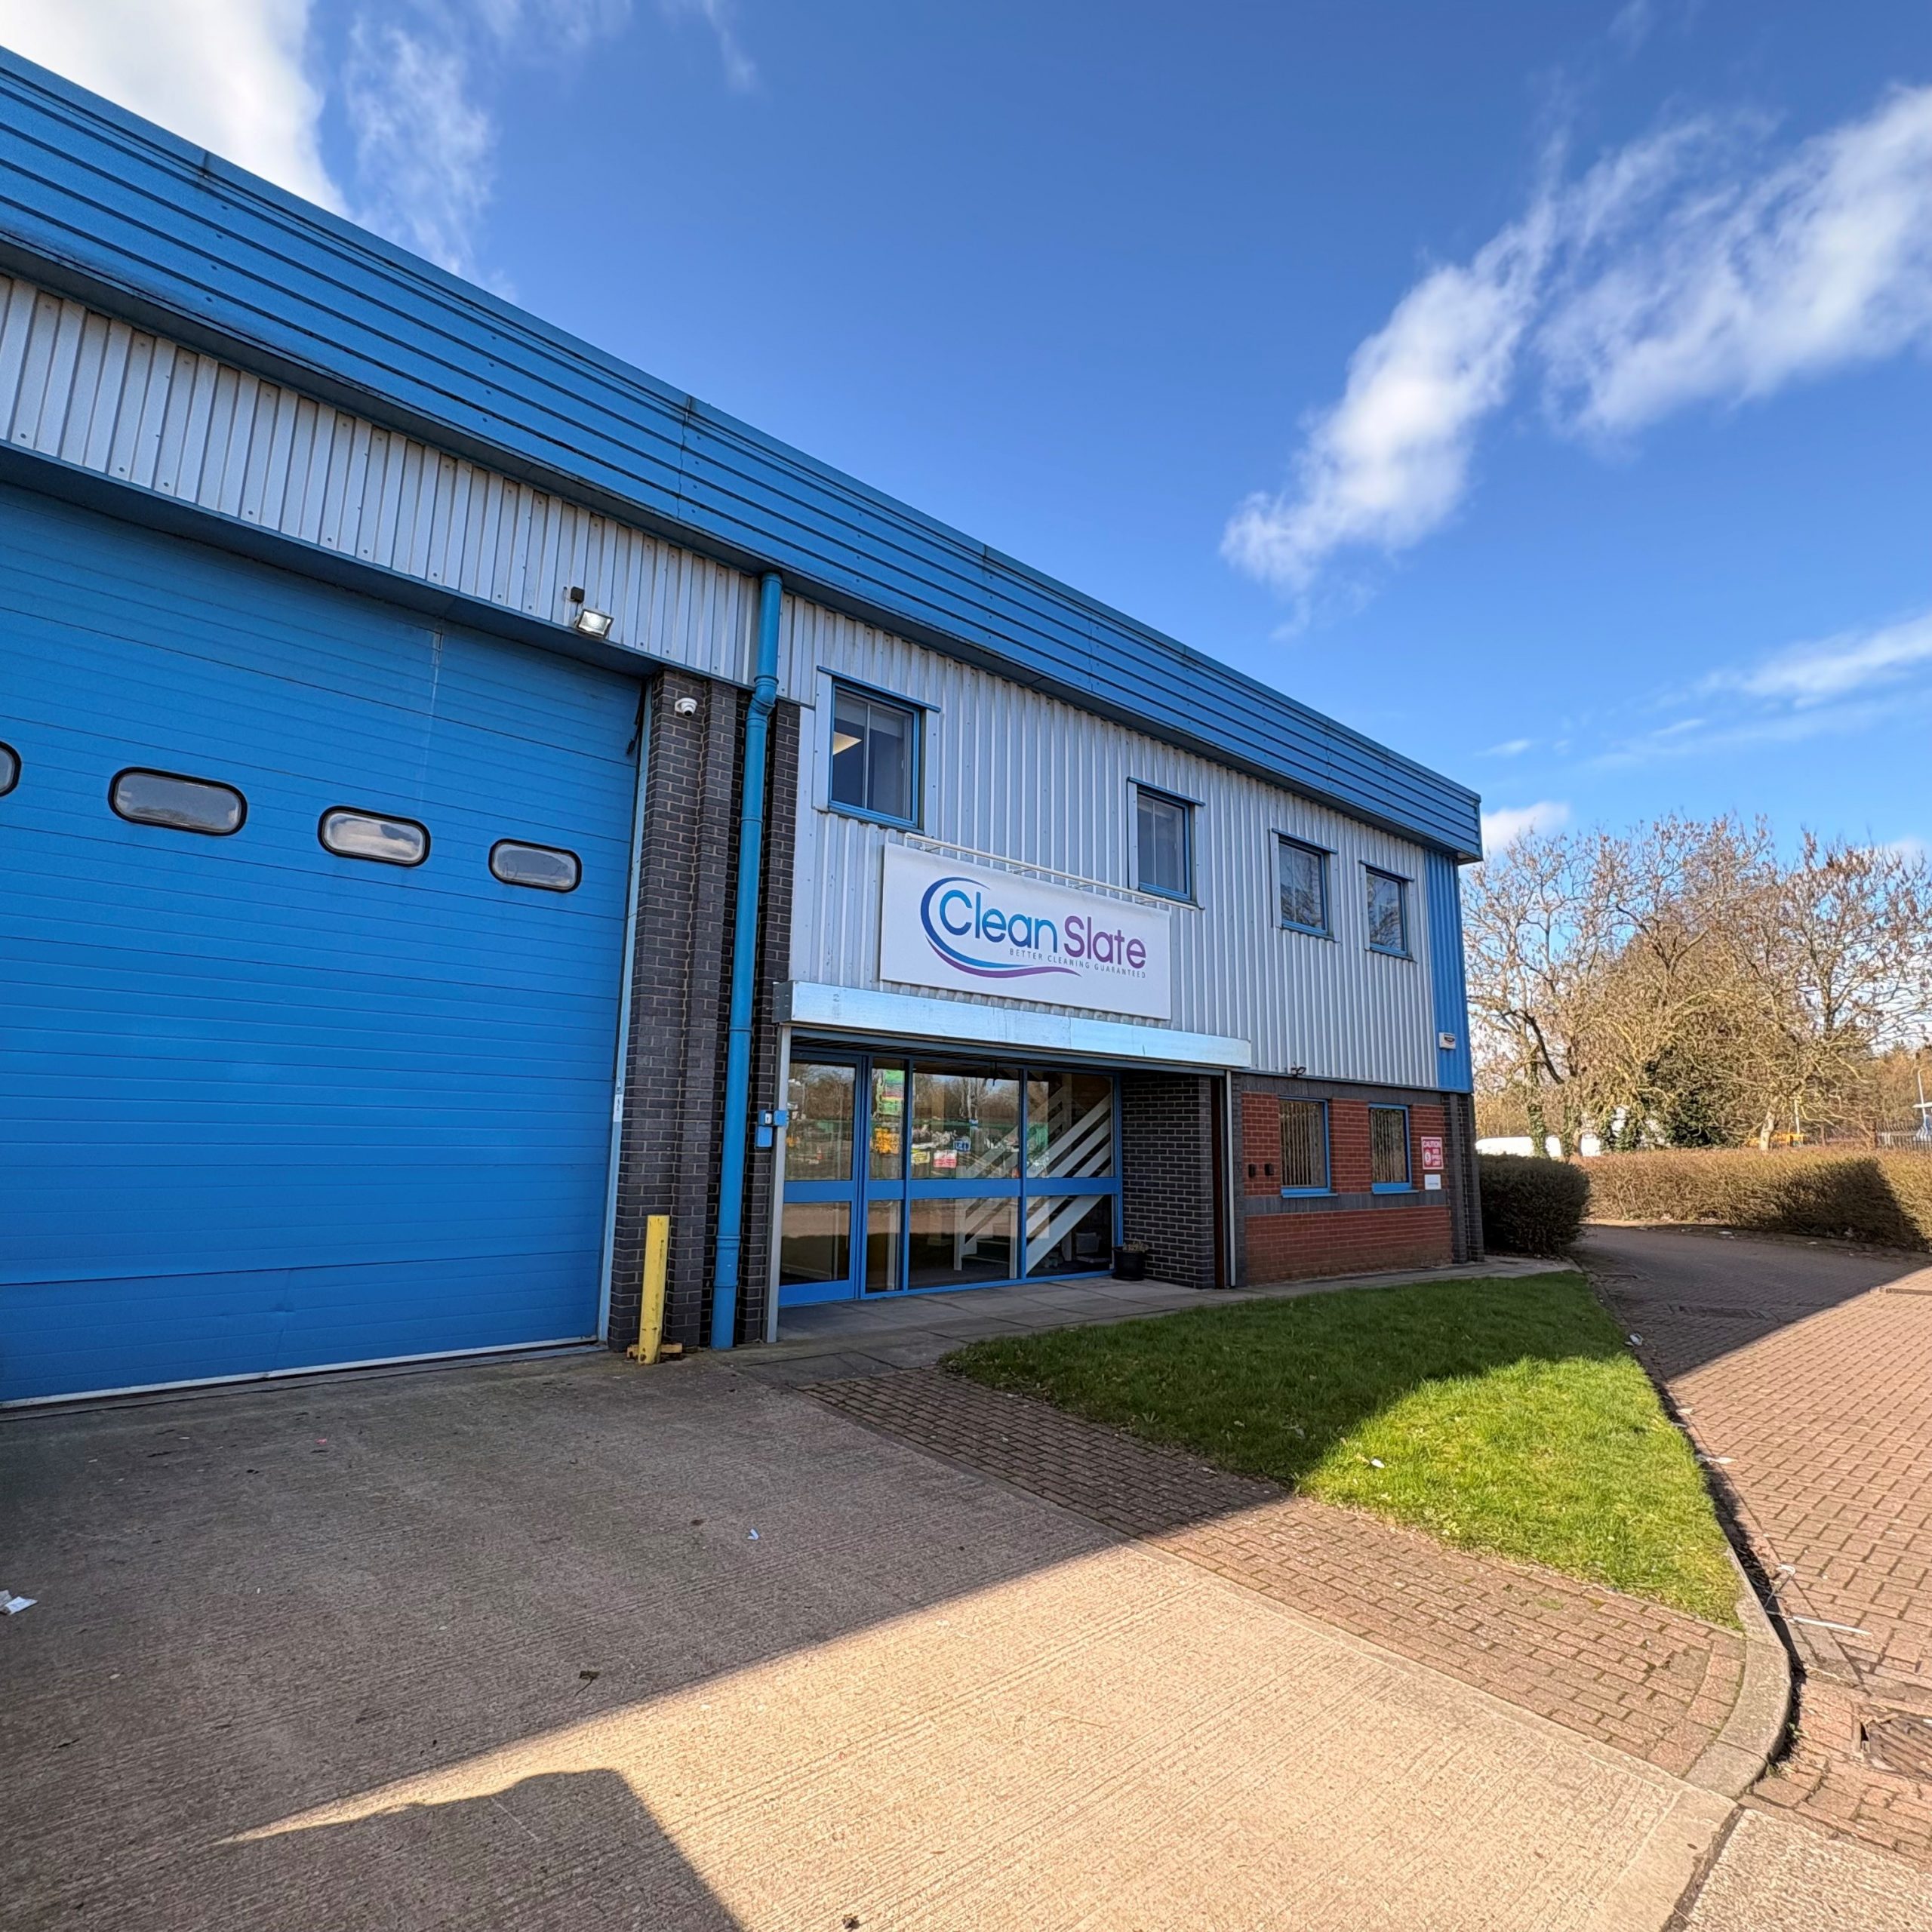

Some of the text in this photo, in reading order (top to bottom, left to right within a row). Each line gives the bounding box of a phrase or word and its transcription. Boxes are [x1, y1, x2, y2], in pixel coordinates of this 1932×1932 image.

[940, 889, 1146, 969] Clean Slate
[1009, 947, 1146, 979] BETTER CLEANING GUARANTEED
